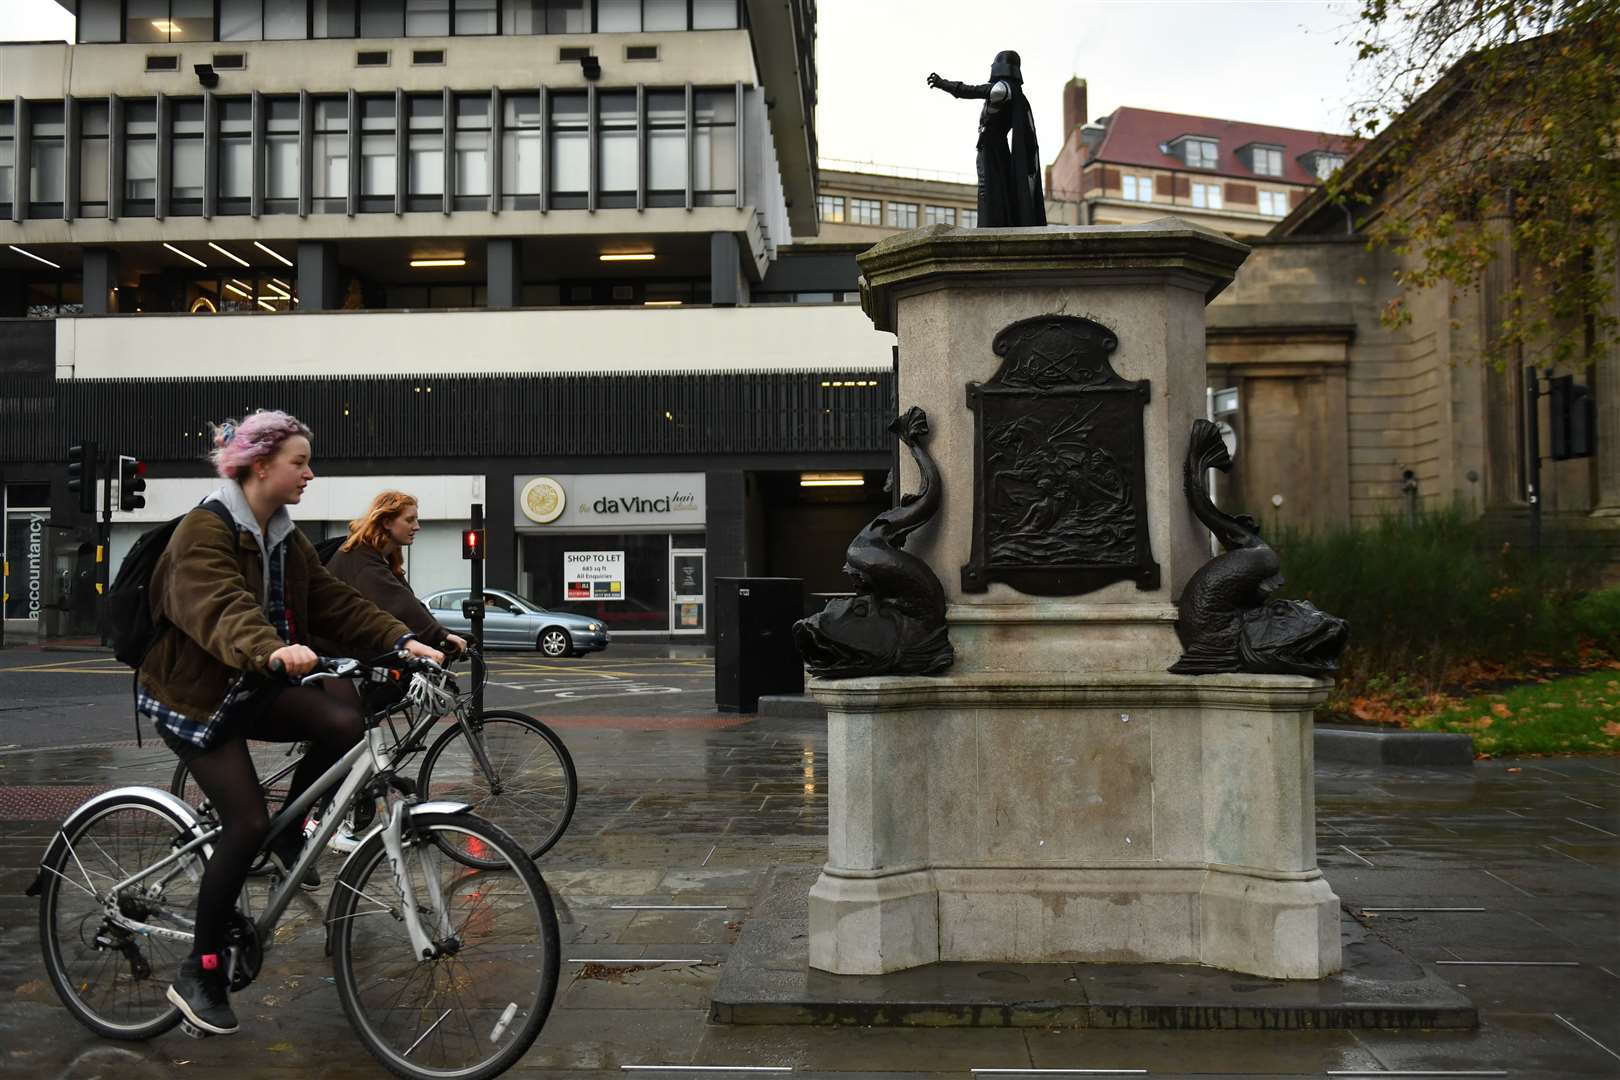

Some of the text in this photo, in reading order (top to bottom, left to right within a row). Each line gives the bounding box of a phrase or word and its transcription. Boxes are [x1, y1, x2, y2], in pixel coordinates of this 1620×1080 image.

[672, 491, 695, 503] hair
[567, 554, 621, 562] SHOP TO LET
[29, 512, 46, 620] accountancy
